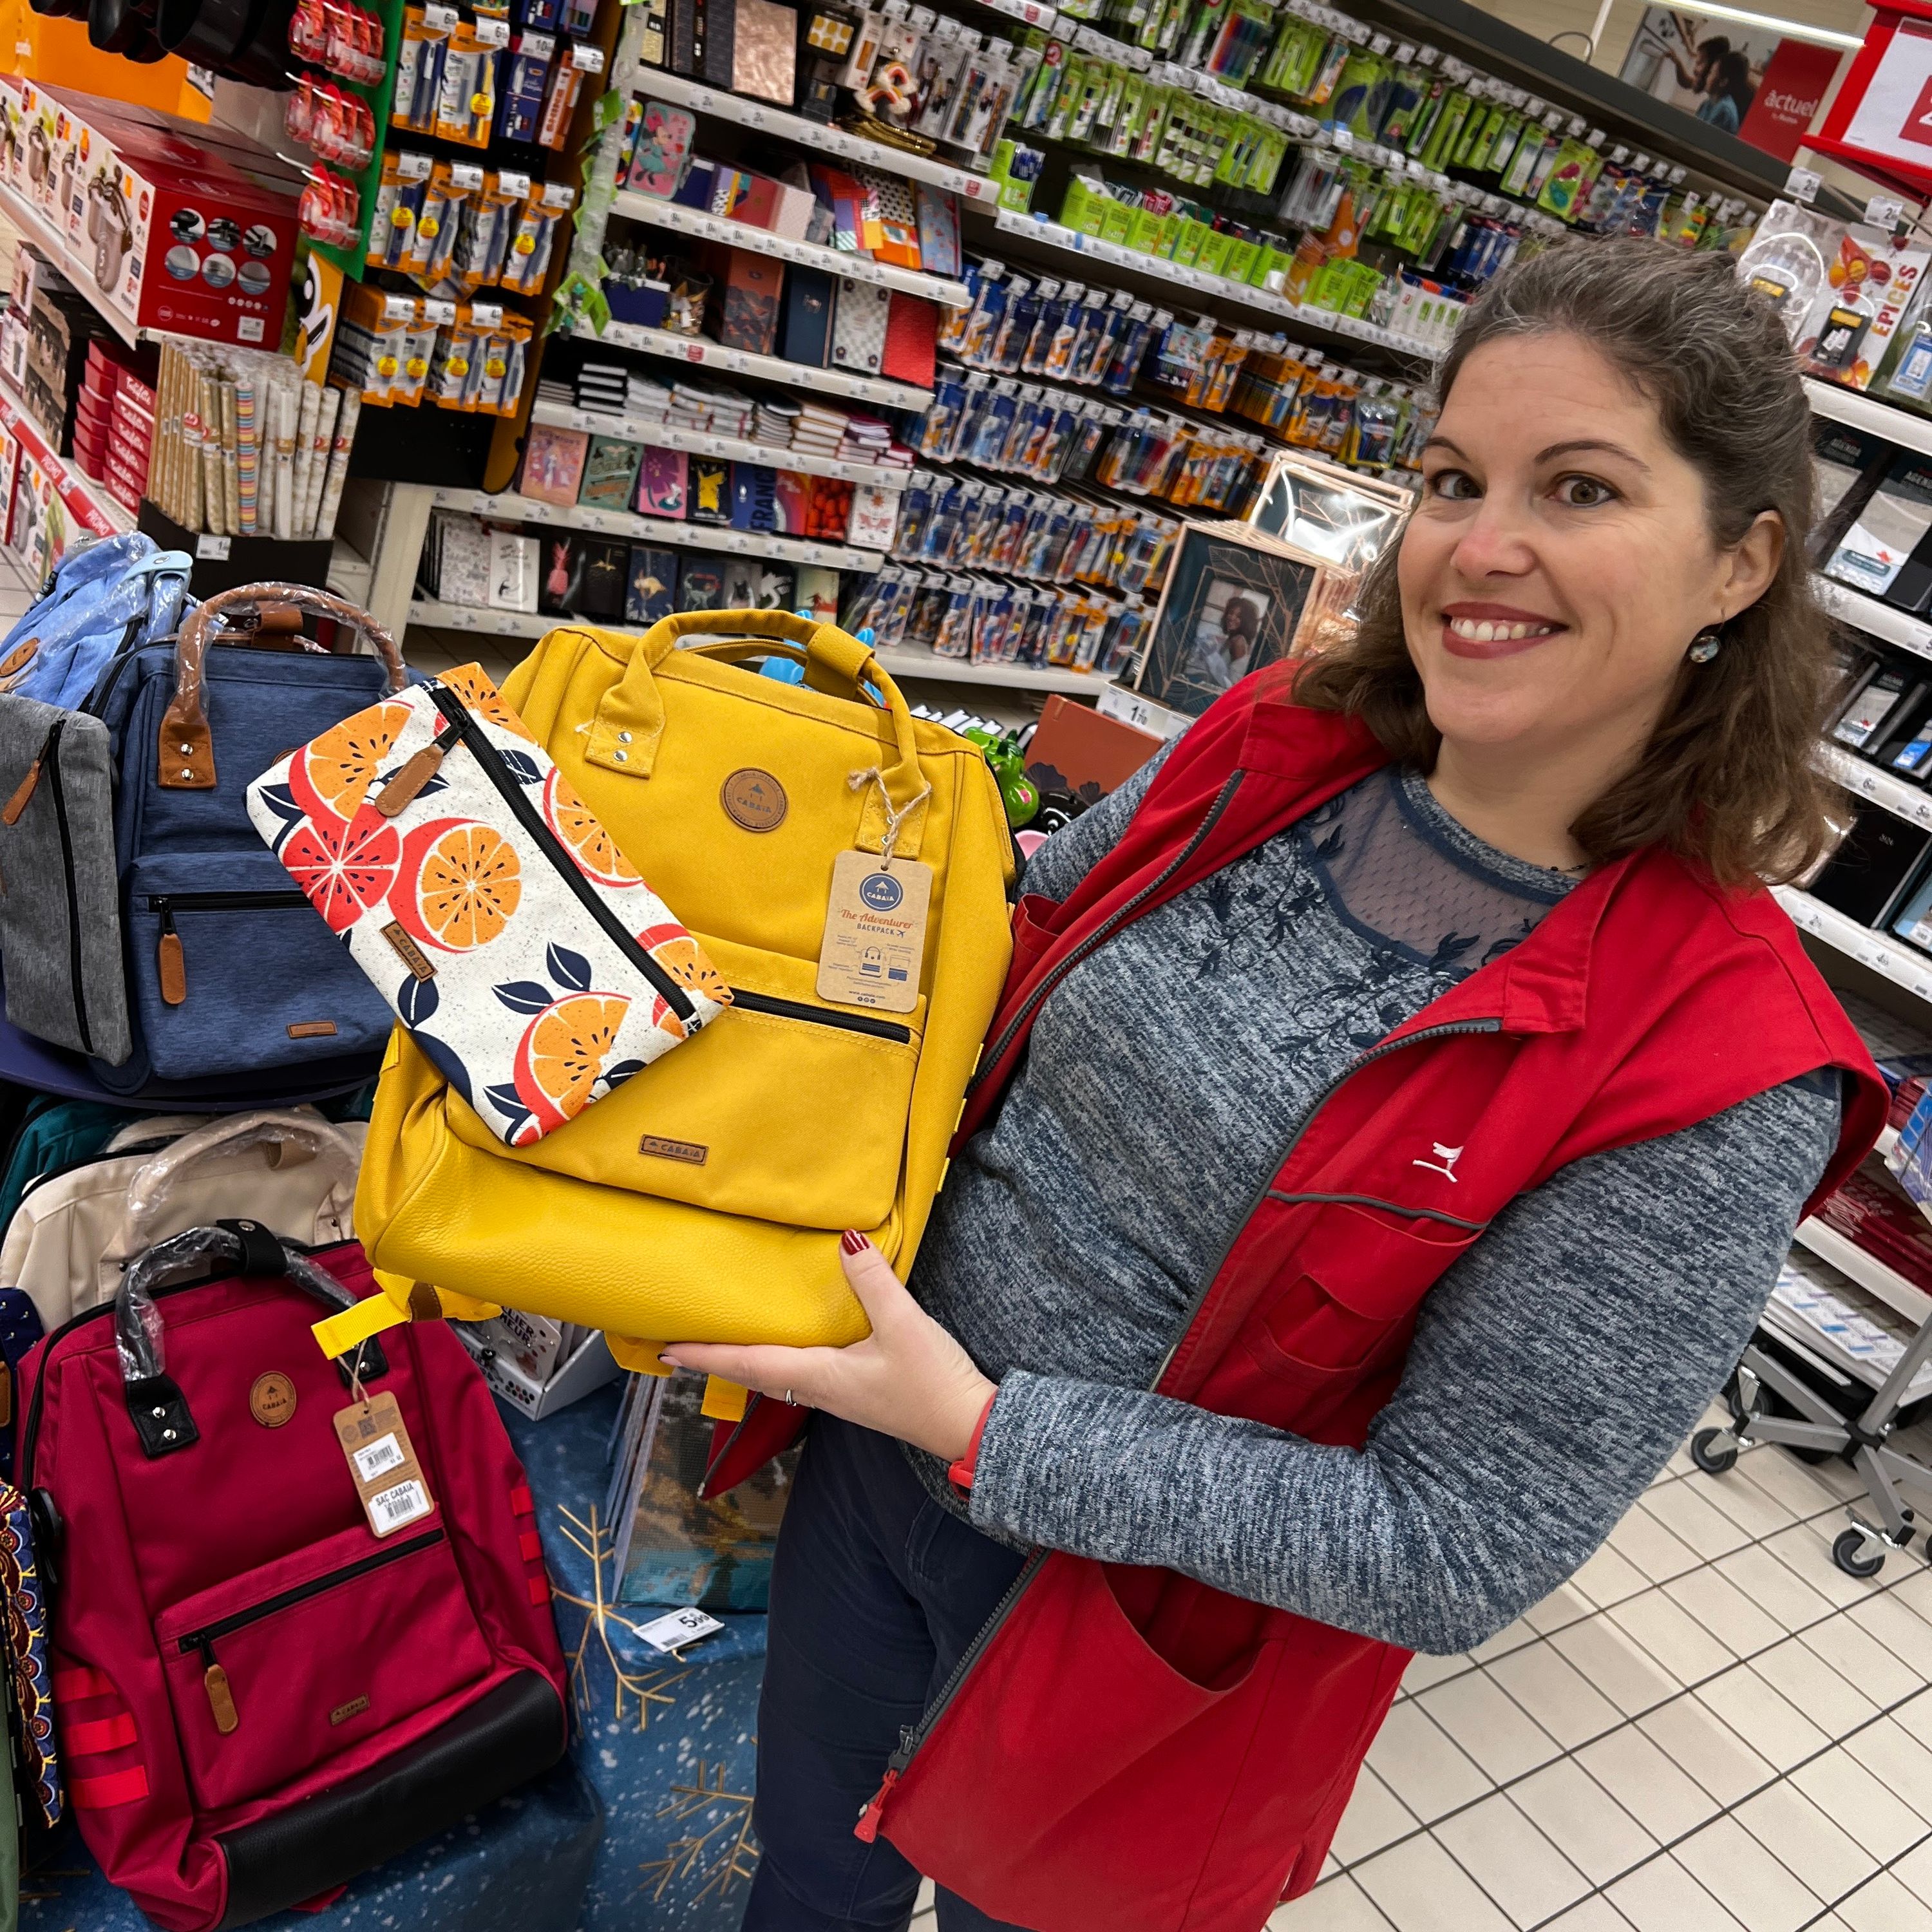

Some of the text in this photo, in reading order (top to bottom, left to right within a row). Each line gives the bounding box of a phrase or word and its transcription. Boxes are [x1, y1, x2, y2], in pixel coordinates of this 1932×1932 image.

[1871, 265, 1918, 337] EPICES
[41, 453, 62, 479] PROMO
[750, 468, 776, 529] FRANC
[86, 509, 110, 537] PROMO
[840, 908, 913, 929] The Adventurer
[857, 923, 895, 935] BACKPACK
[390, 1482, 415, 1499] CABAIA
